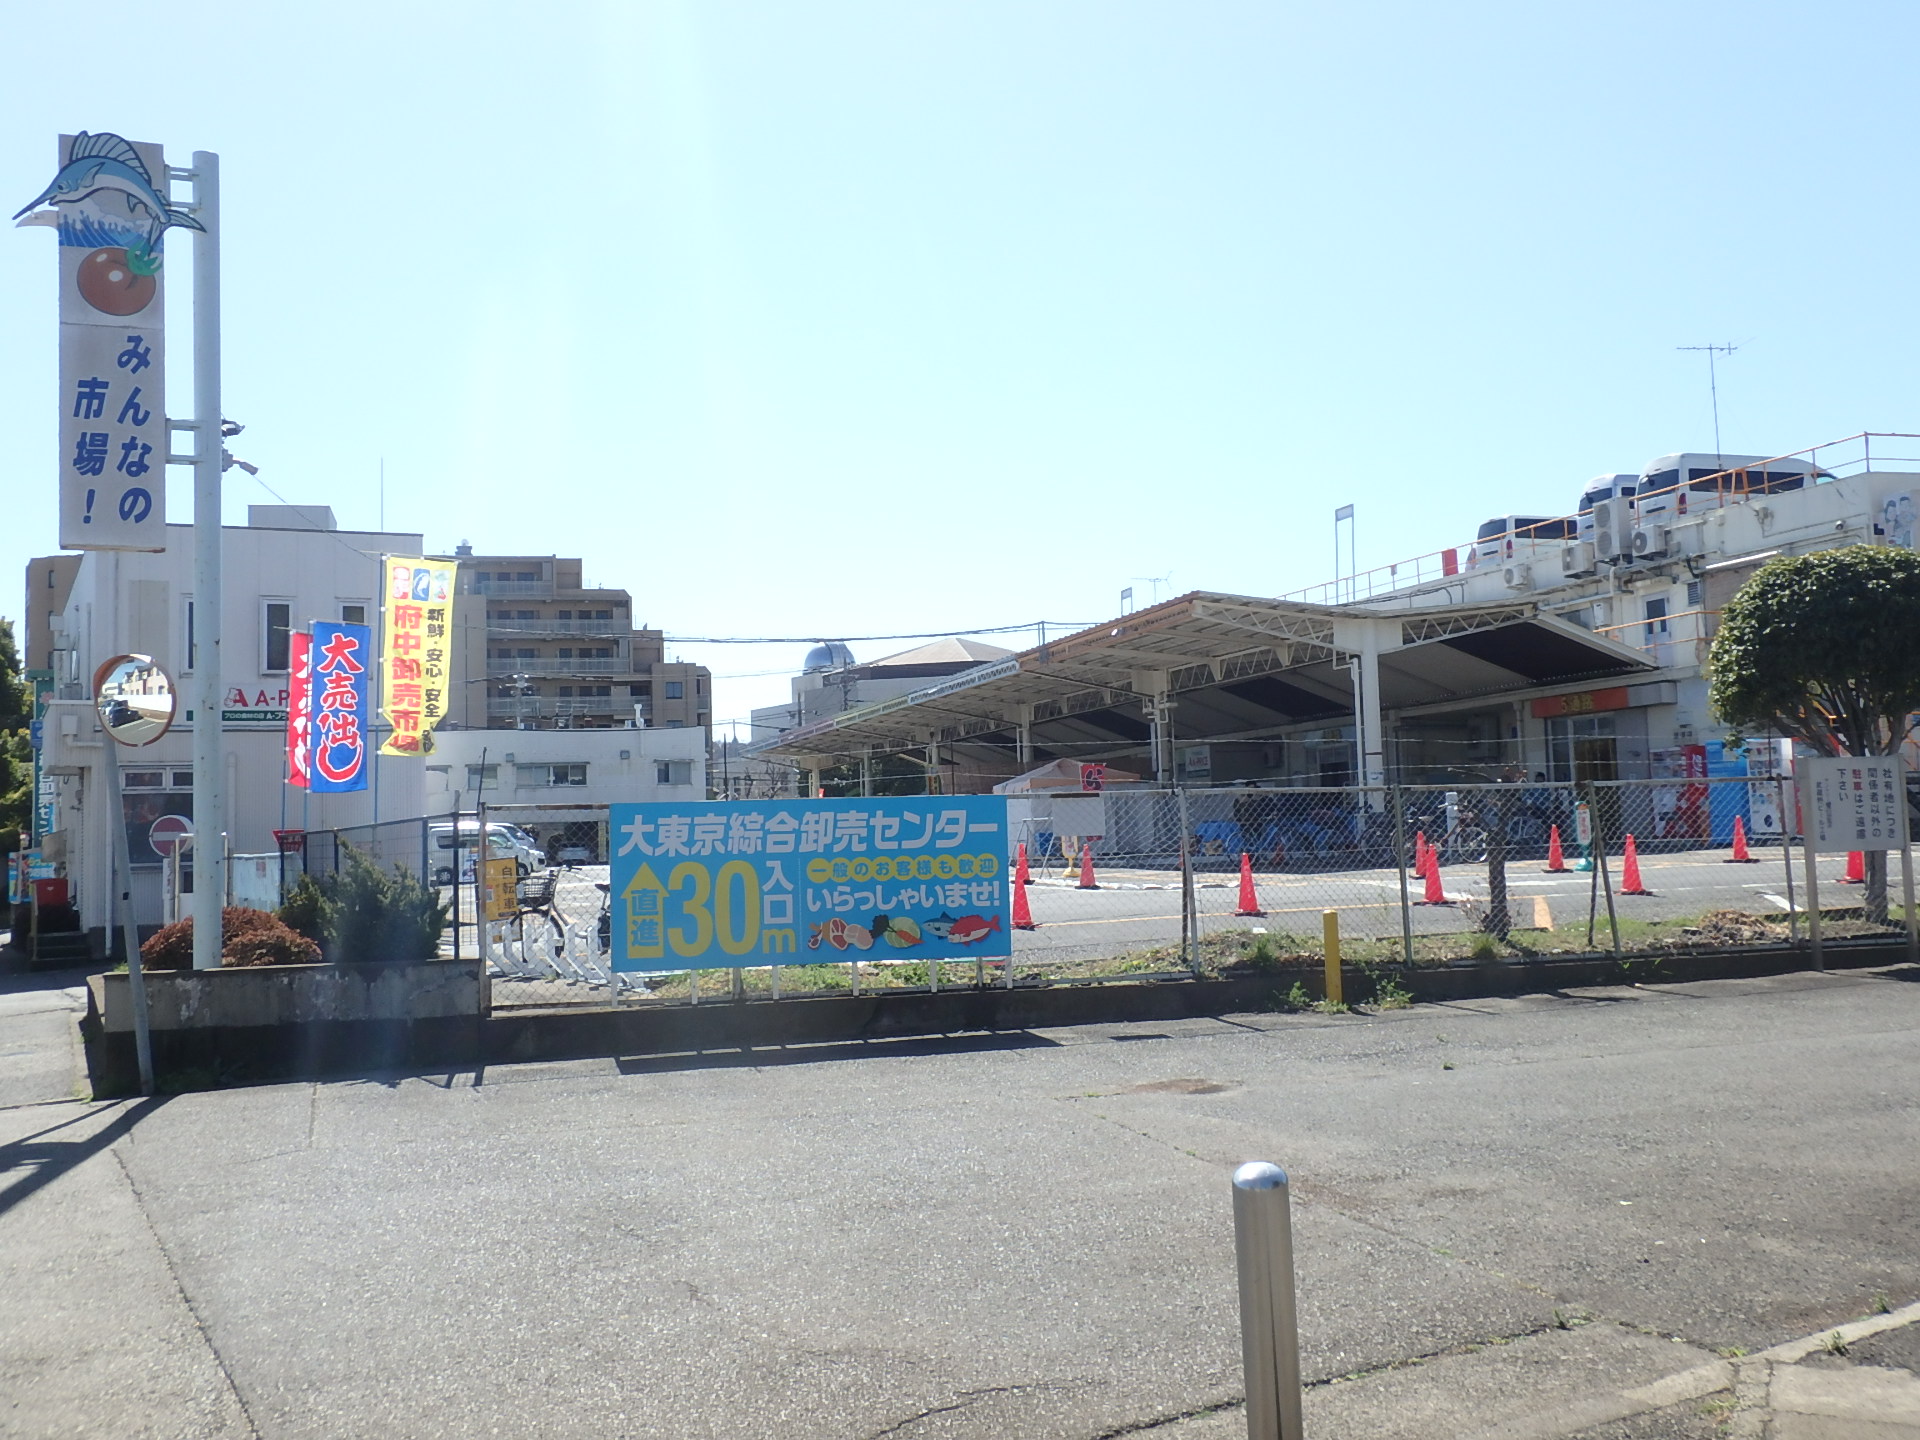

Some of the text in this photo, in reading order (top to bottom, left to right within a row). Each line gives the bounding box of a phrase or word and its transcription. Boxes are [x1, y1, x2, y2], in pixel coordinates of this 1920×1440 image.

[72, 377, 109, 524] 市場!
[117, 335, 152, 524] みんなの
[316, 632, 364, 783] 大売出し
[390, 604, 422, 752] 府中卸売市場
[1836, 768, 1848, 801] 下さい
[1882, 768, 1896, 839] 社有地につき
[617, 809, 998, 857] 大東京綜合卸売センター
[762, 860, 794, 925] 入口
[806, 880, 1000, 912] いらっしゃいませ!
[811, 858, 995, 878] 一般のお客様も歓迎
[630, 888, 660, 947] 直進
